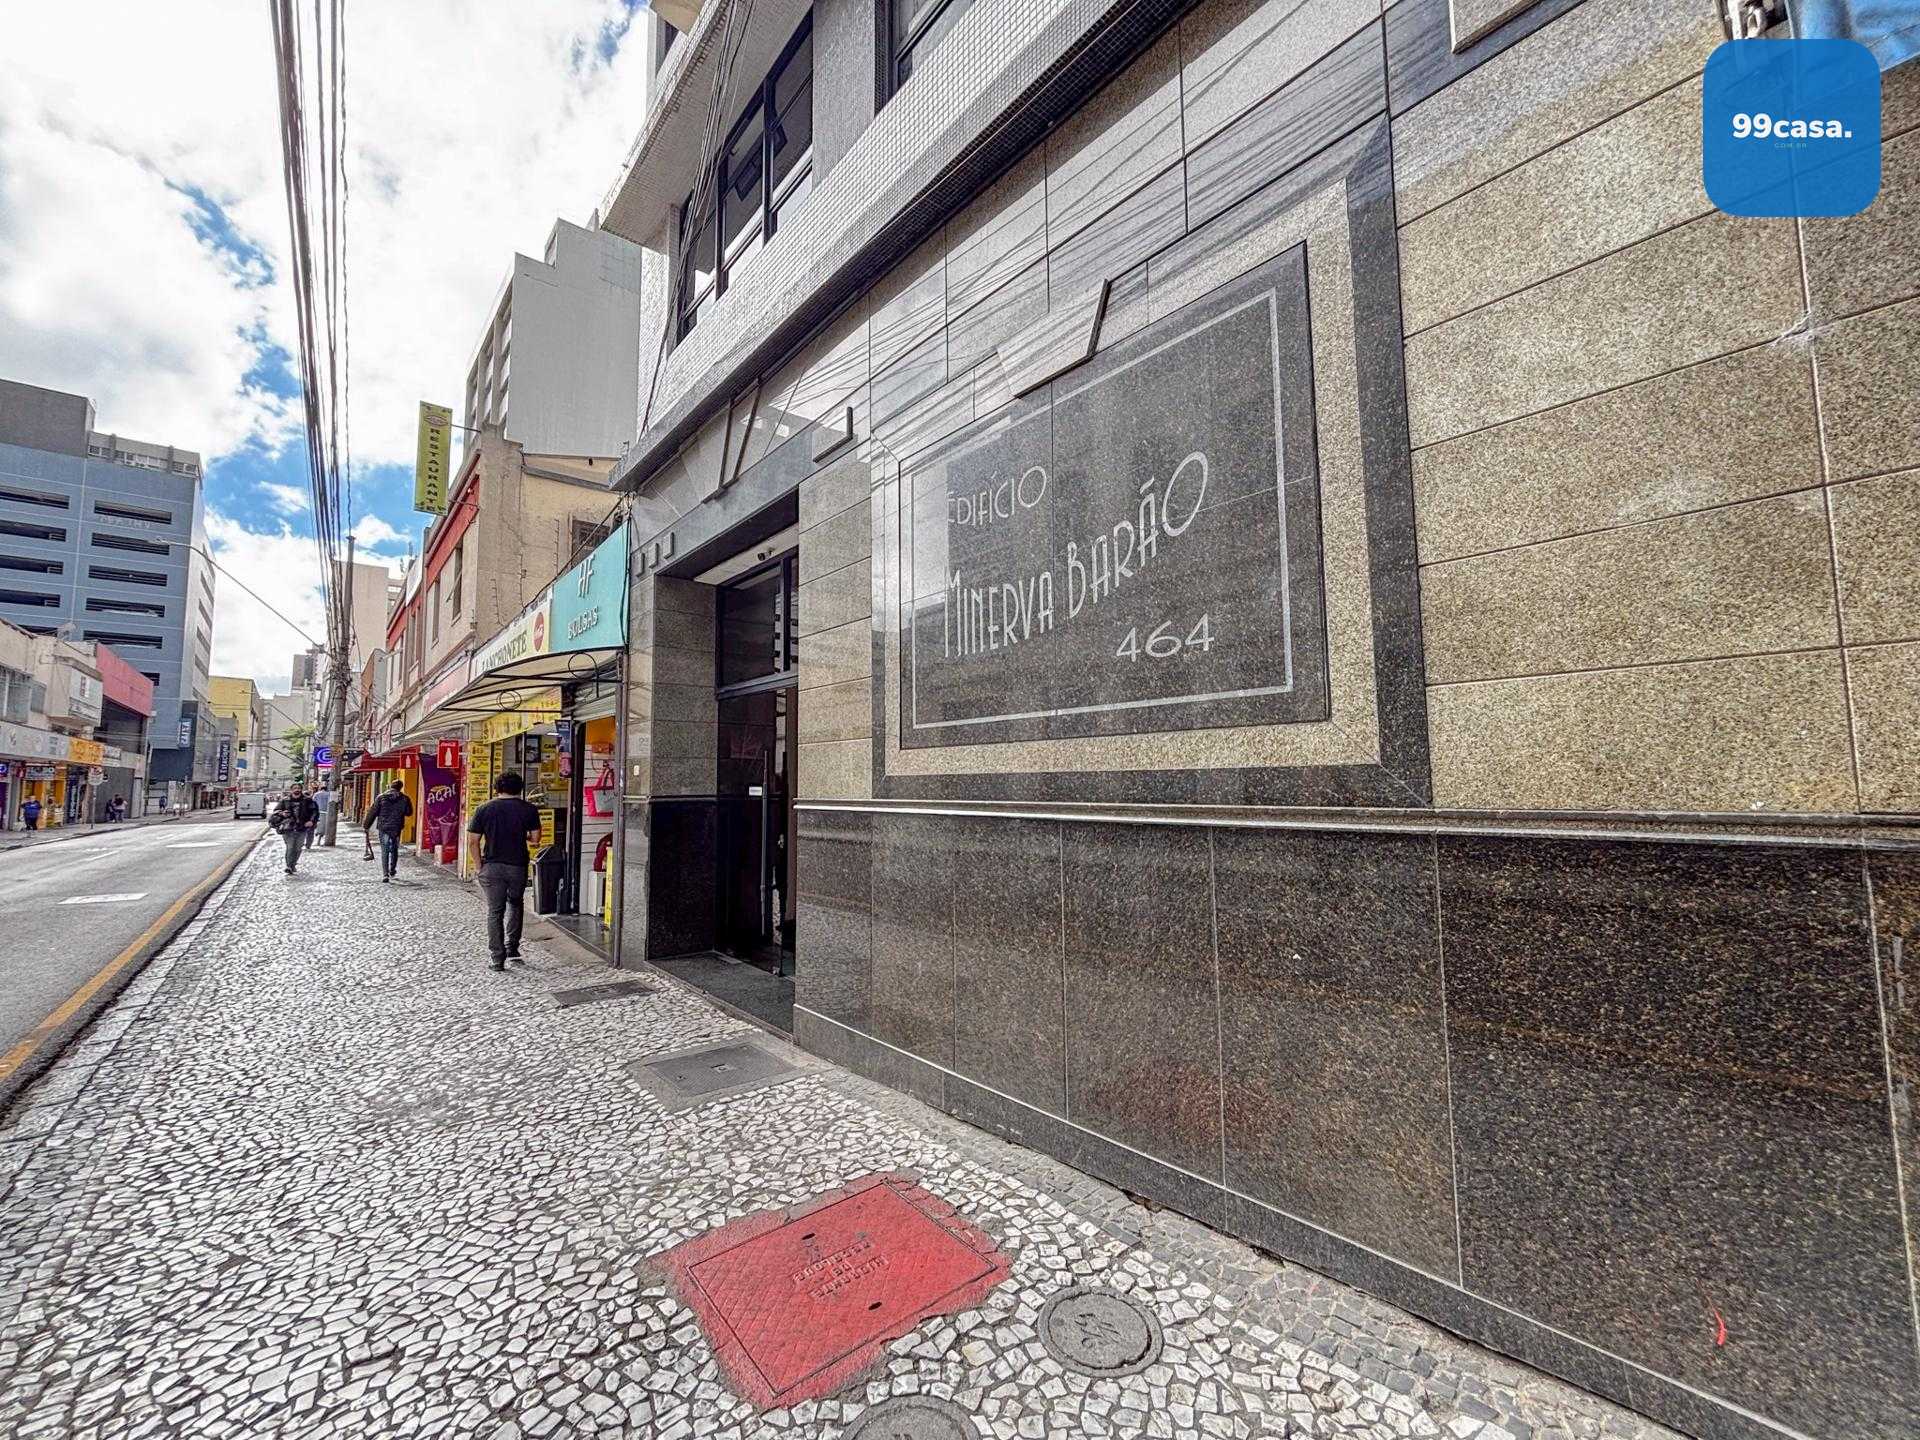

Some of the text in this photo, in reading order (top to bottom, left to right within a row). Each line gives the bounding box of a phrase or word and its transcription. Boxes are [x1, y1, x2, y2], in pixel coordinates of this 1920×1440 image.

[567, 606, 599, 640] BOLSAS
[945, 570, 1053, 657] MINERVA
[1116, 613, 1214, 662] 464
